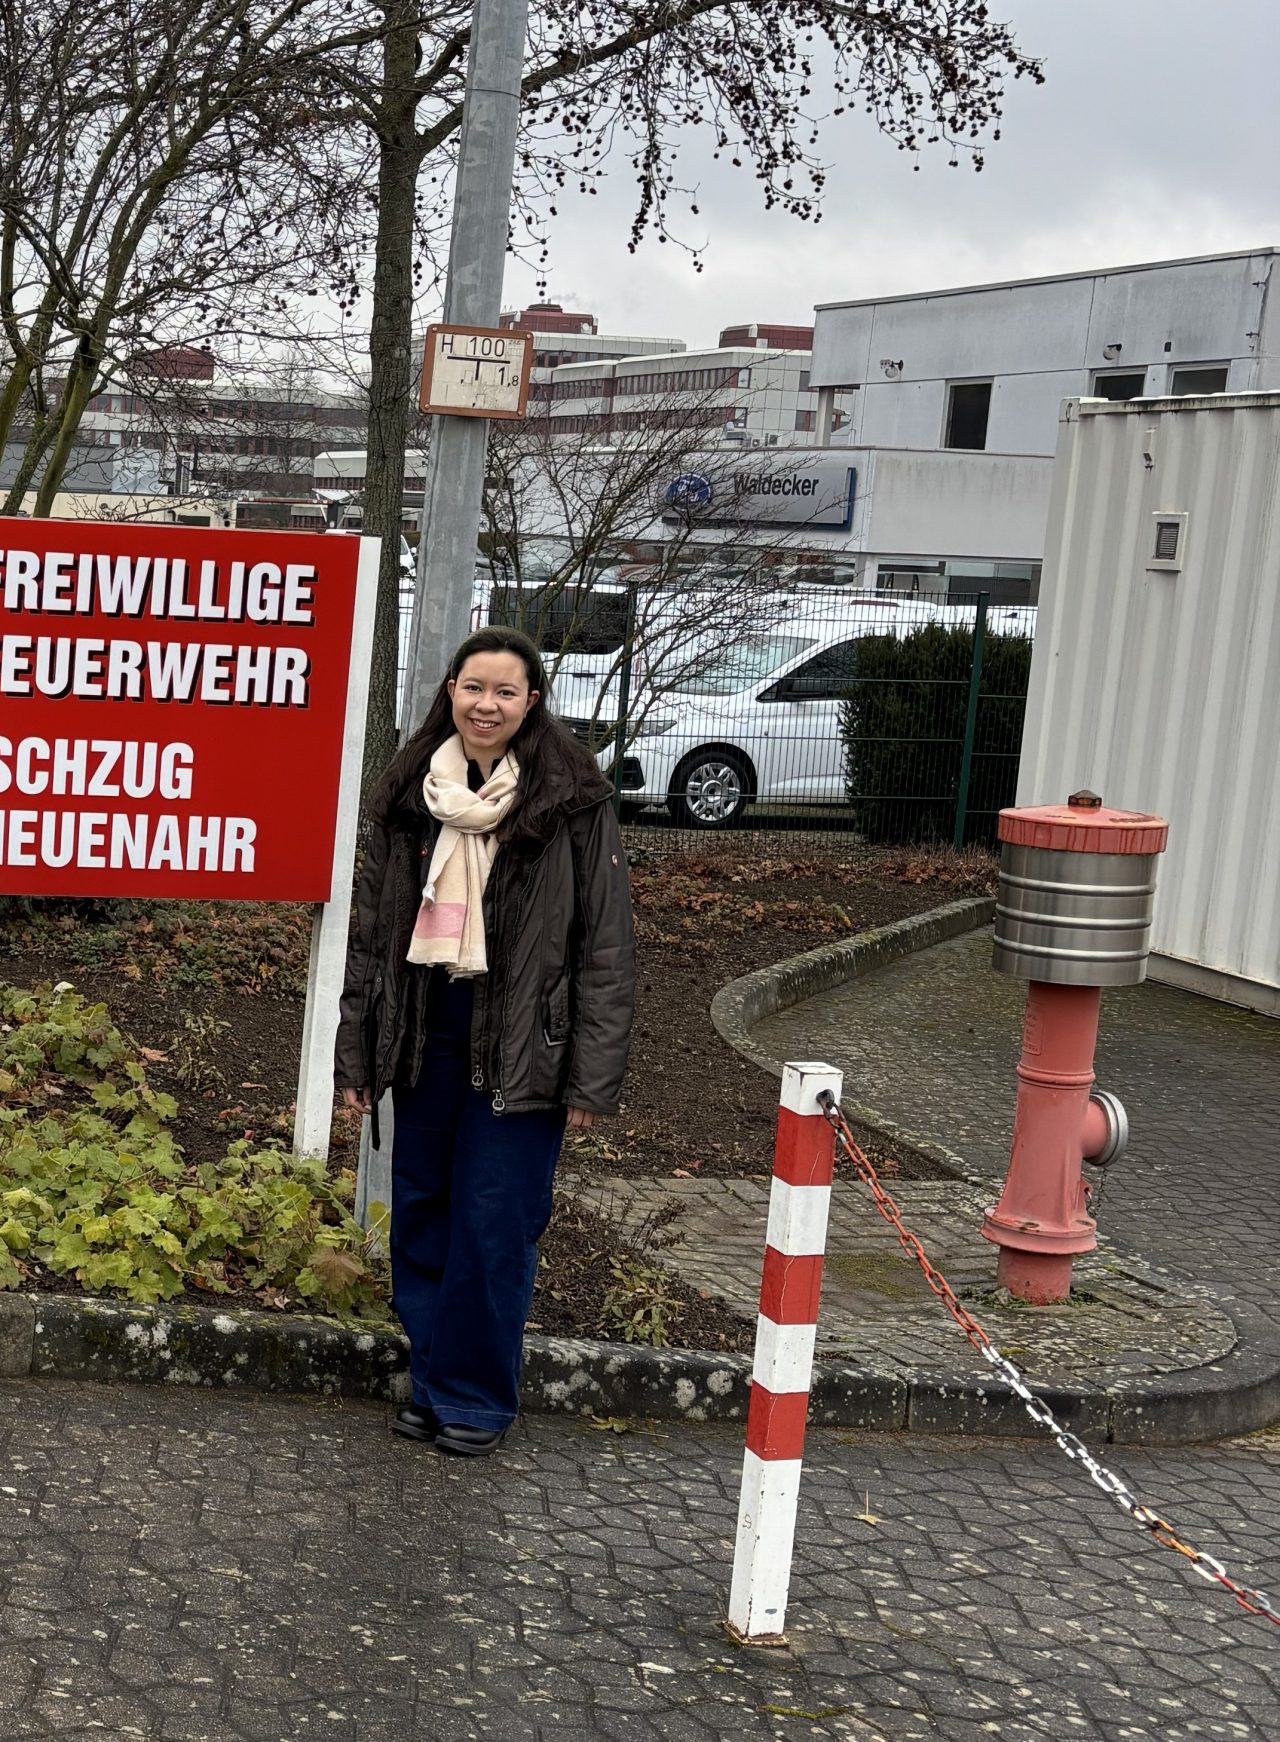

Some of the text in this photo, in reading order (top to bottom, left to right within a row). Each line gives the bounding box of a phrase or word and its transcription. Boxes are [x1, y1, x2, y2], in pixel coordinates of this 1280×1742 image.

[441, 335, 454, 353] H
[469, 336, 505, 357] 100
[733, 474, 819, 497] Waldecker
